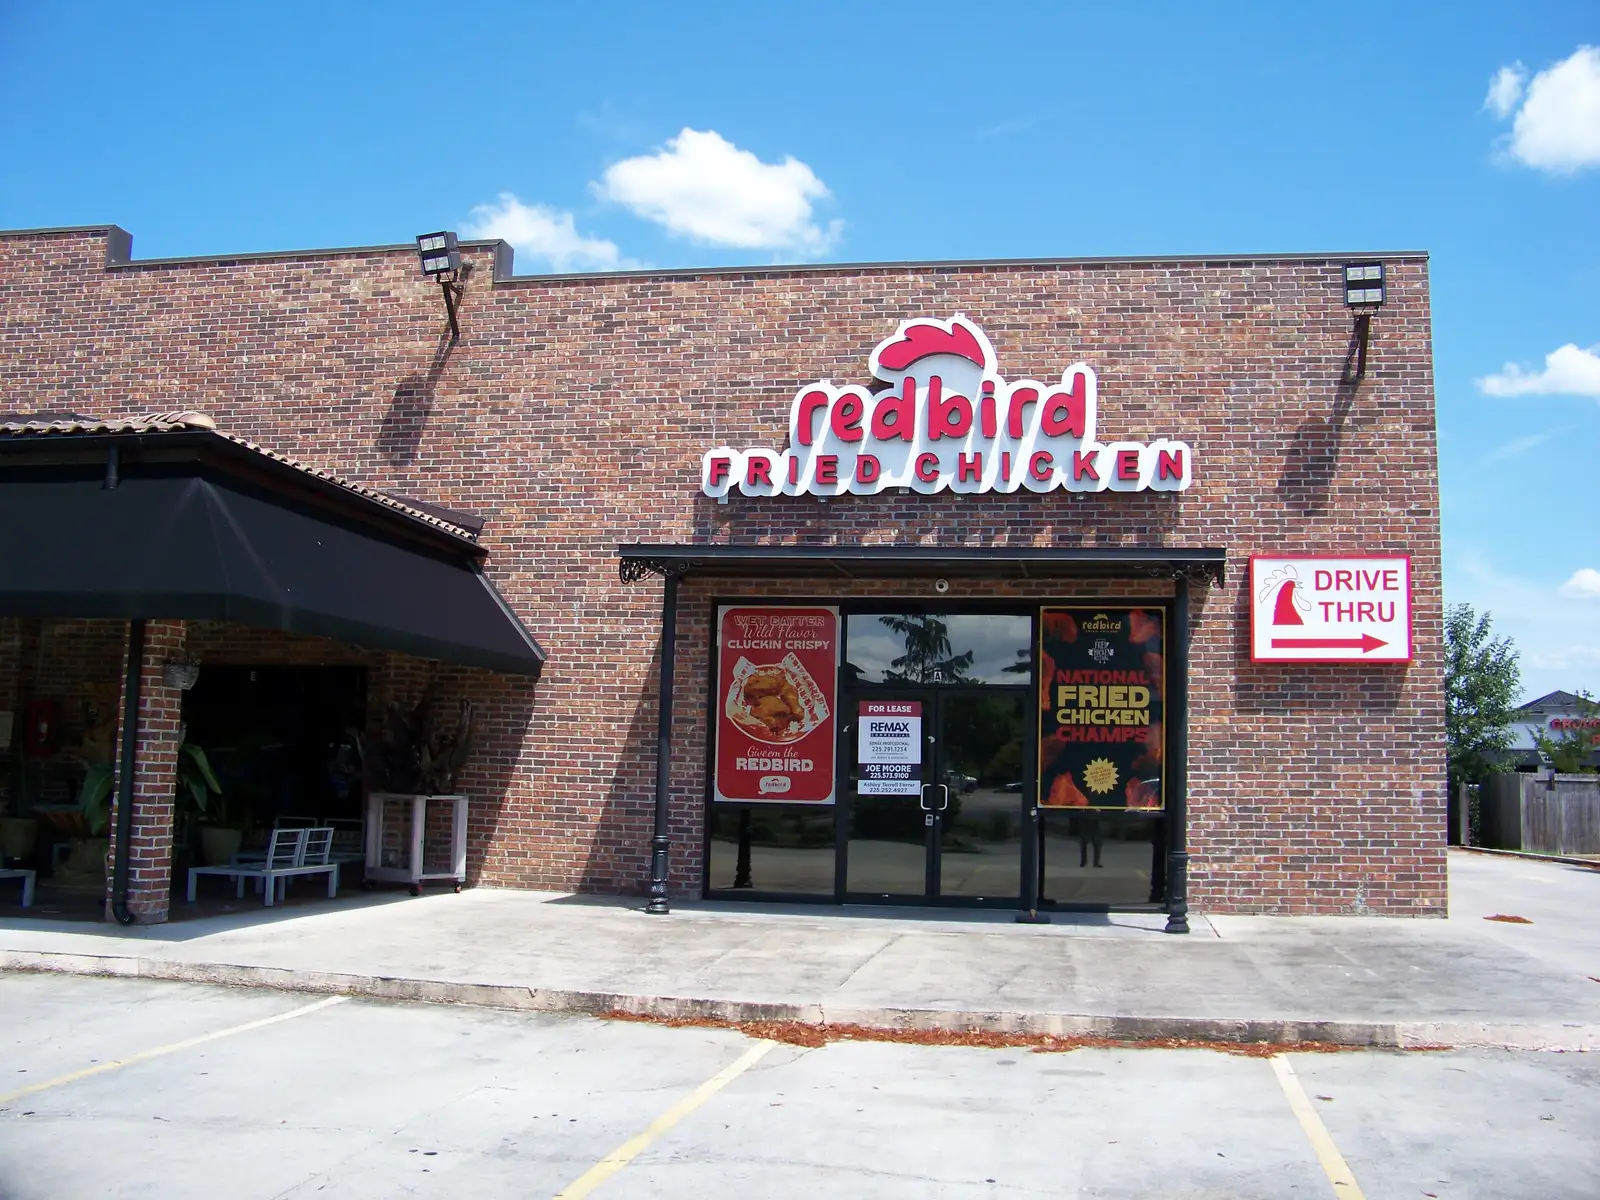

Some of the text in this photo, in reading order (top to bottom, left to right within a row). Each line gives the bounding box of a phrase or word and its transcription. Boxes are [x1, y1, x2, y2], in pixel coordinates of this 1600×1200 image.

[798, 372, 1086, 446] redbird
[709, 449, 1183, 487] FRIED CHICKEN
[1315, 570, 1399, 591] DRIVE
[1318, 602, 1395, 622] THRU
[734, 615, 824, 627] WET BATTER
[1082, 620, 1122, 630] redbird
[742, 624, 818, 639] Wild Flavor
[727, 640, 830, 650] CLUCKIN CRISPY
[934, 671, 942, 682] A
[1056, 670, 1150, 685] NATIONAL
[1057, 685, 1150, 708] FRIED
[868, 705, 912, 713] FOR LEASE
[1056, 709, 1150, 725] CHICKEN
[1055, 726, 1150, 743] CHAMPS
[783, 746, 799, 758] the
[736, 758, 814, 772] REDBIRD
[865, 765, 912, 773] JOE MOORE
